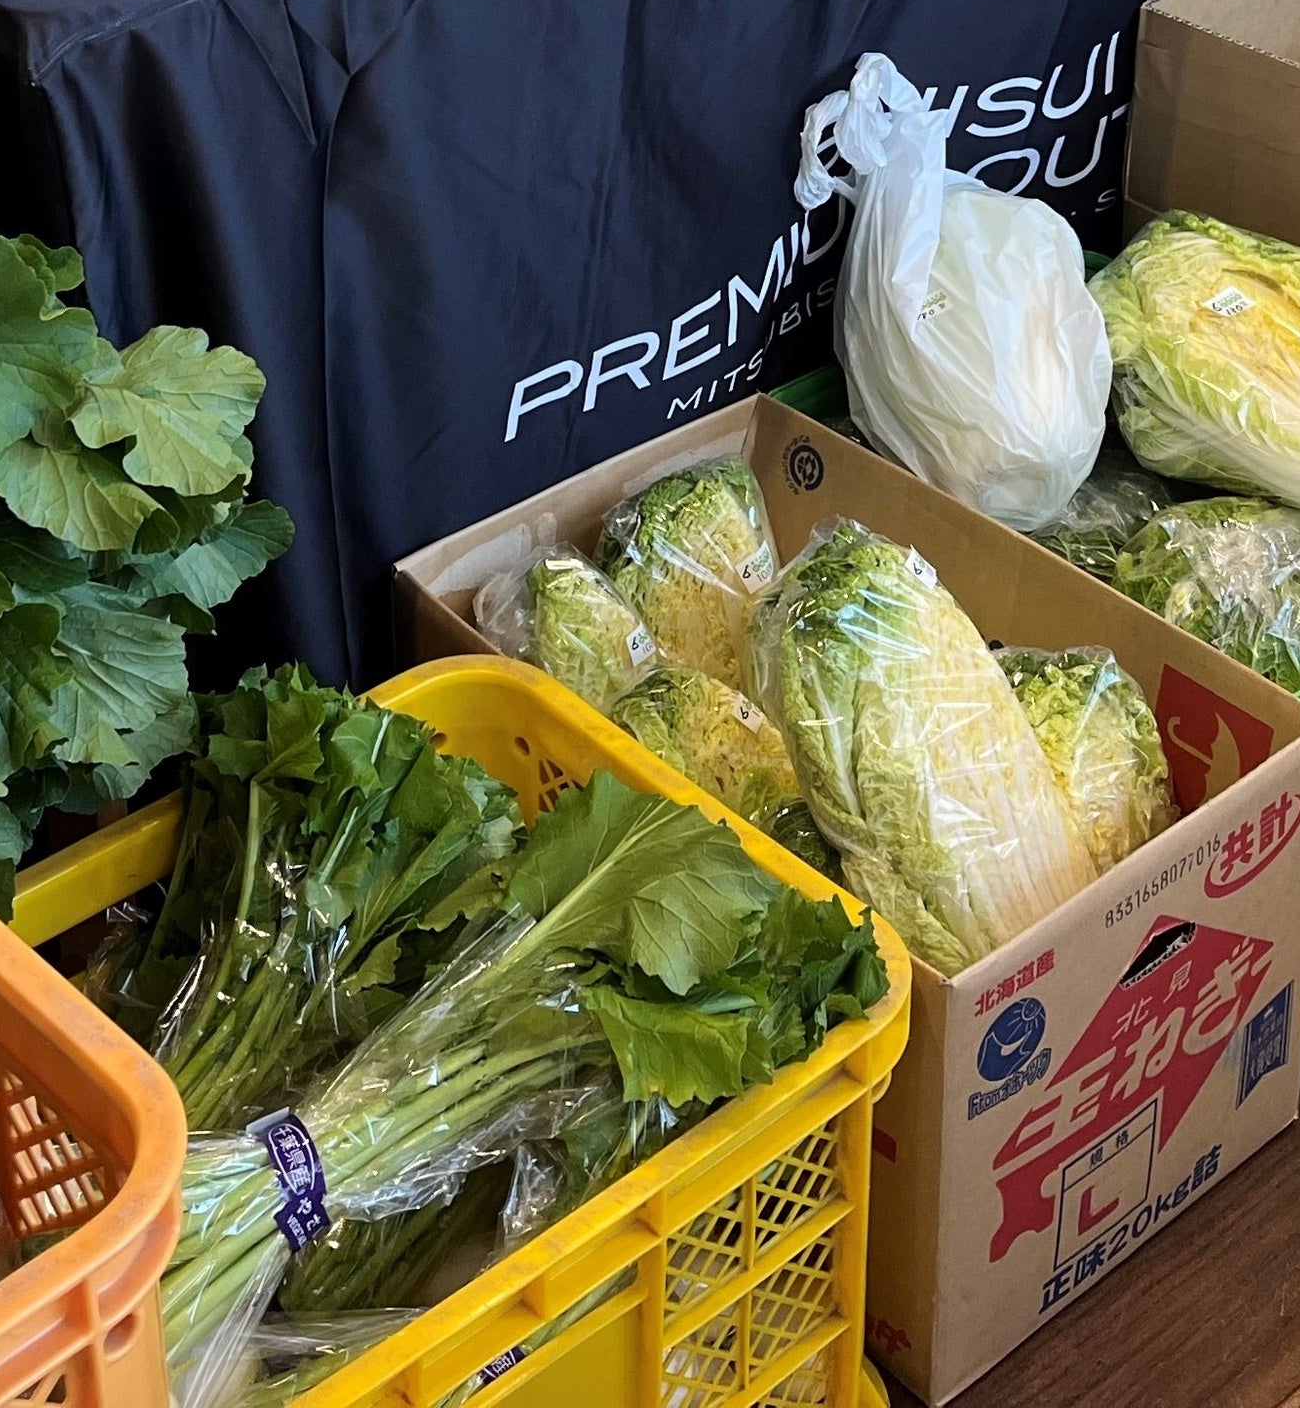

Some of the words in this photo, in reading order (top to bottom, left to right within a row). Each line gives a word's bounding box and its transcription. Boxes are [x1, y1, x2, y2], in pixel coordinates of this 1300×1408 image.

[1219, 791, 1293, 883] 共計
[1104, 832, 1221, 929] 8331658077016
[975, 947, 1055, 1018] 北海道産
[1110, 959, 1192, 1041] 北見
[273, 1125, 312, 1190] 千葉県産
[1038, 1143, 1223, 1316] 正味20kg詰
[1077, 1185, 1120, 1236] L
